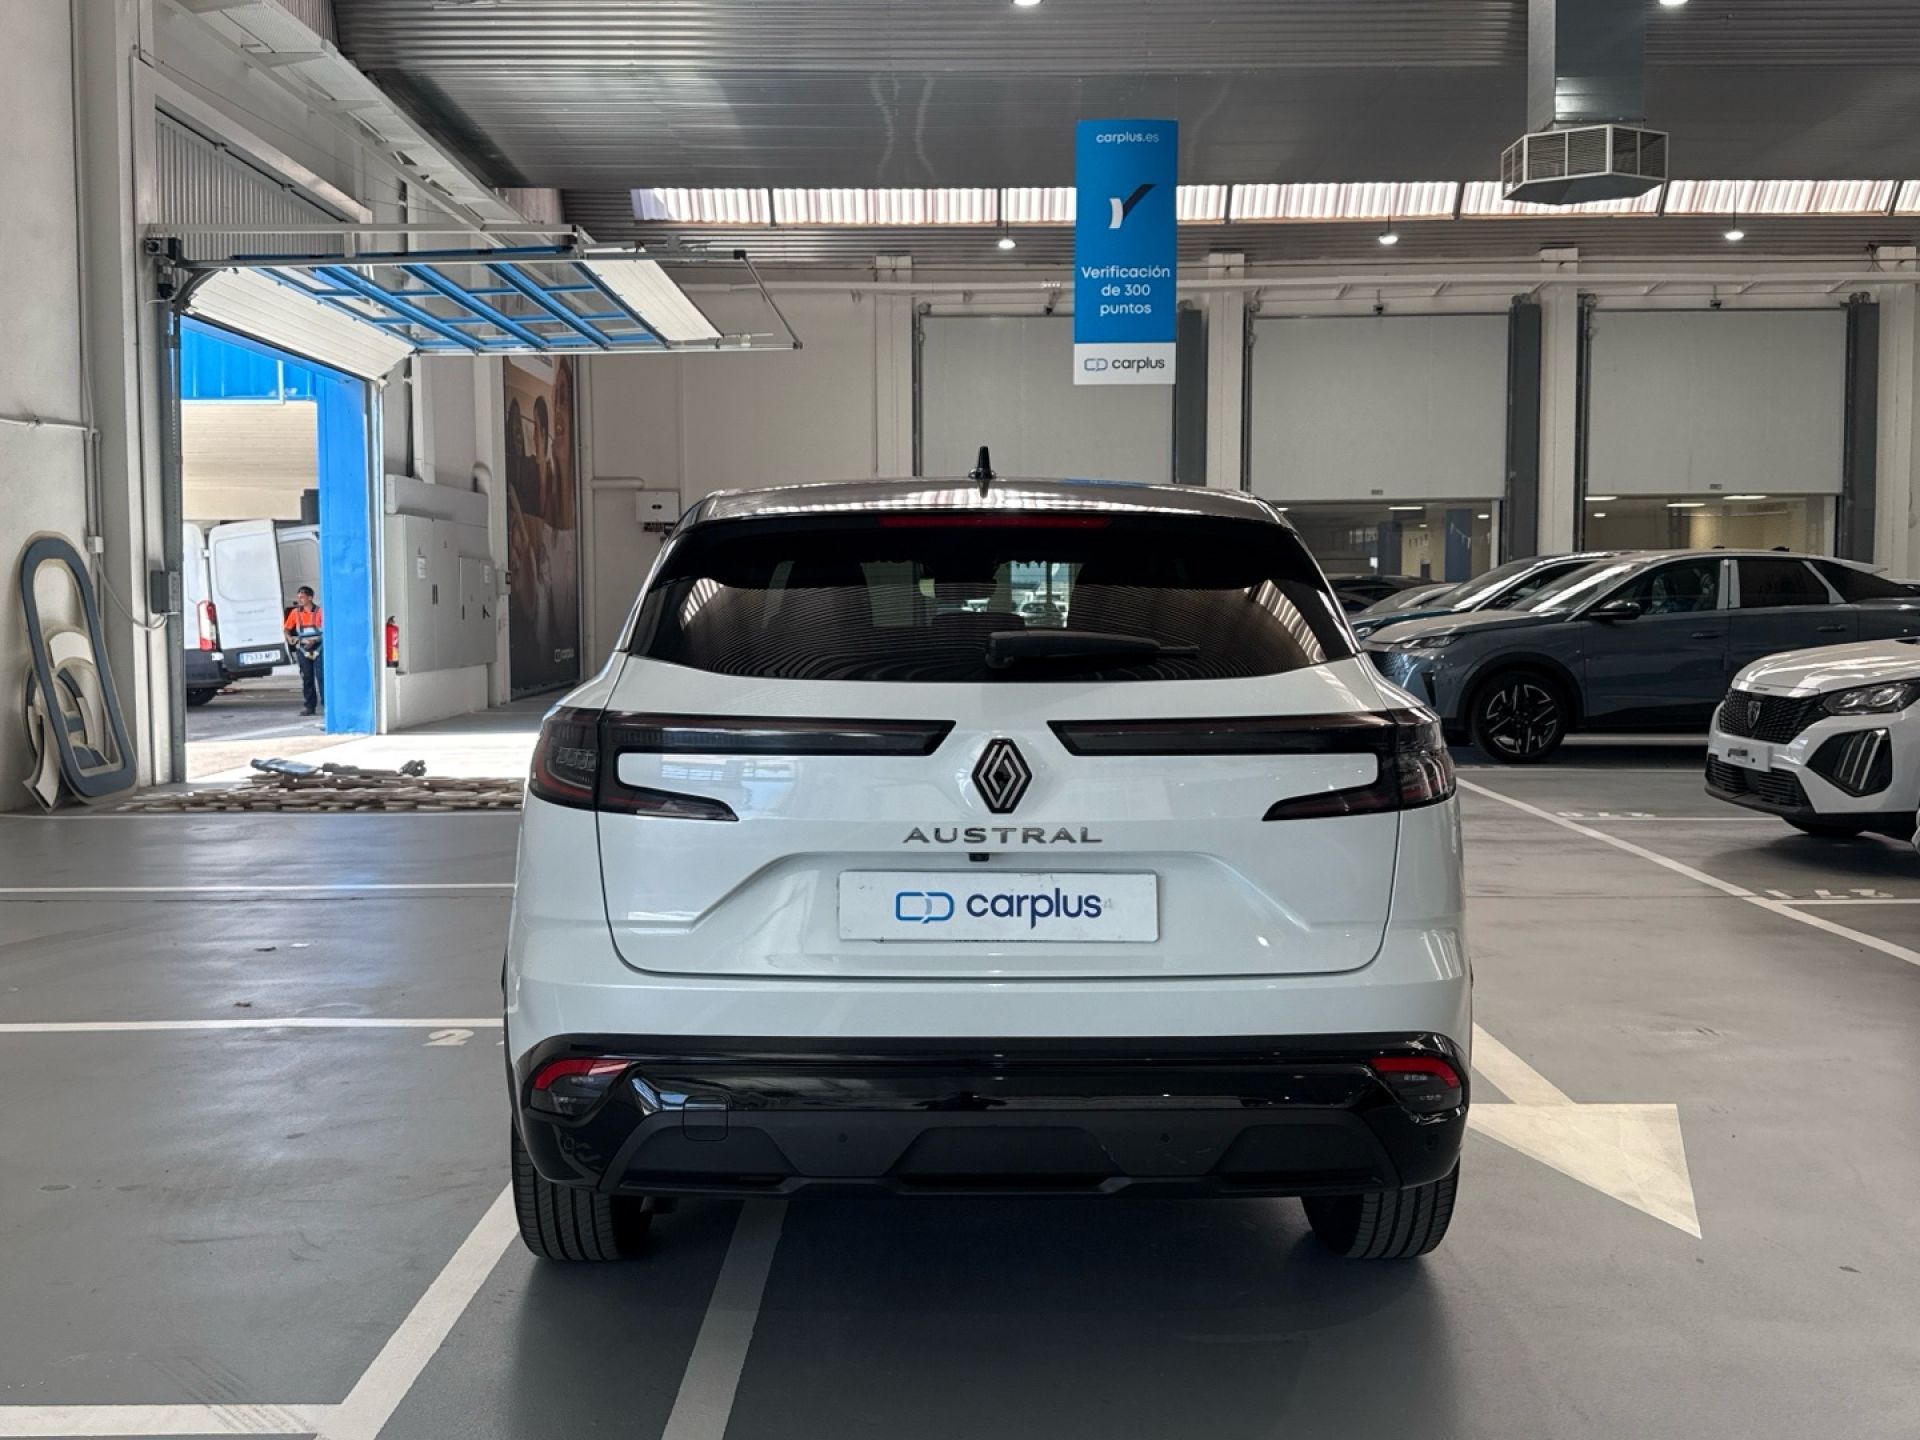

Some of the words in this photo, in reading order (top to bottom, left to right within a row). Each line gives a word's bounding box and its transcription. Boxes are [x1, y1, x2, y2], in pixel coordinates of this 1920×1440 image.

[1096, 131, 1160, 145] carplus.es
[1081, 265, 1170, 279] Verificación
[1101, 284, 1121, 297] de
[1124, 284, 1151, 297] 300
[1100, 303, 1152, 317] puntos
[1111, 356, 1165, 373] carplus
[903, 826, 1103, 844] AUSTRAL
[966, 887, 1102, 930] carplus
